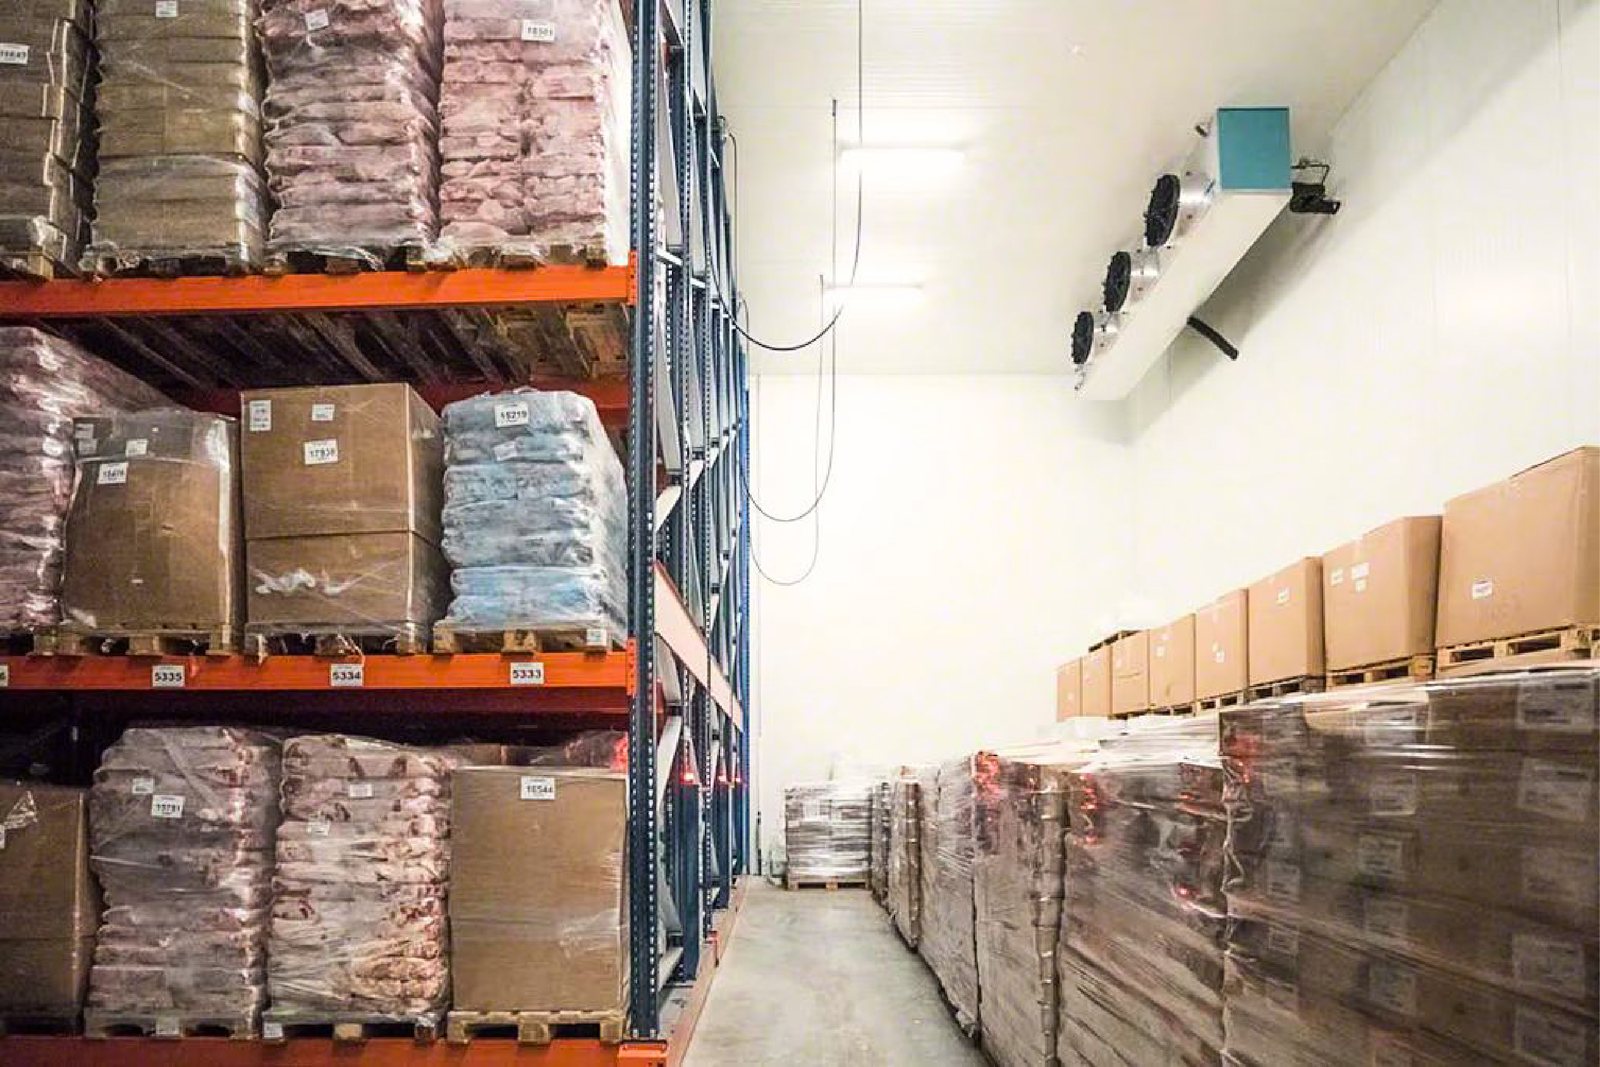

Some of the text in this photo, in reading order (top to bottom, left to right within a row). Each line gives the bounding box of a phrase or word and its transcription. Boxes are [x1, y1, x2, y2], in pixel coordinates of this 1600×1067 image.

[154, 672, 182, 681] 5335
[332, 671, 361, 680] 5334
[513, 669, 541, 679] 5333
